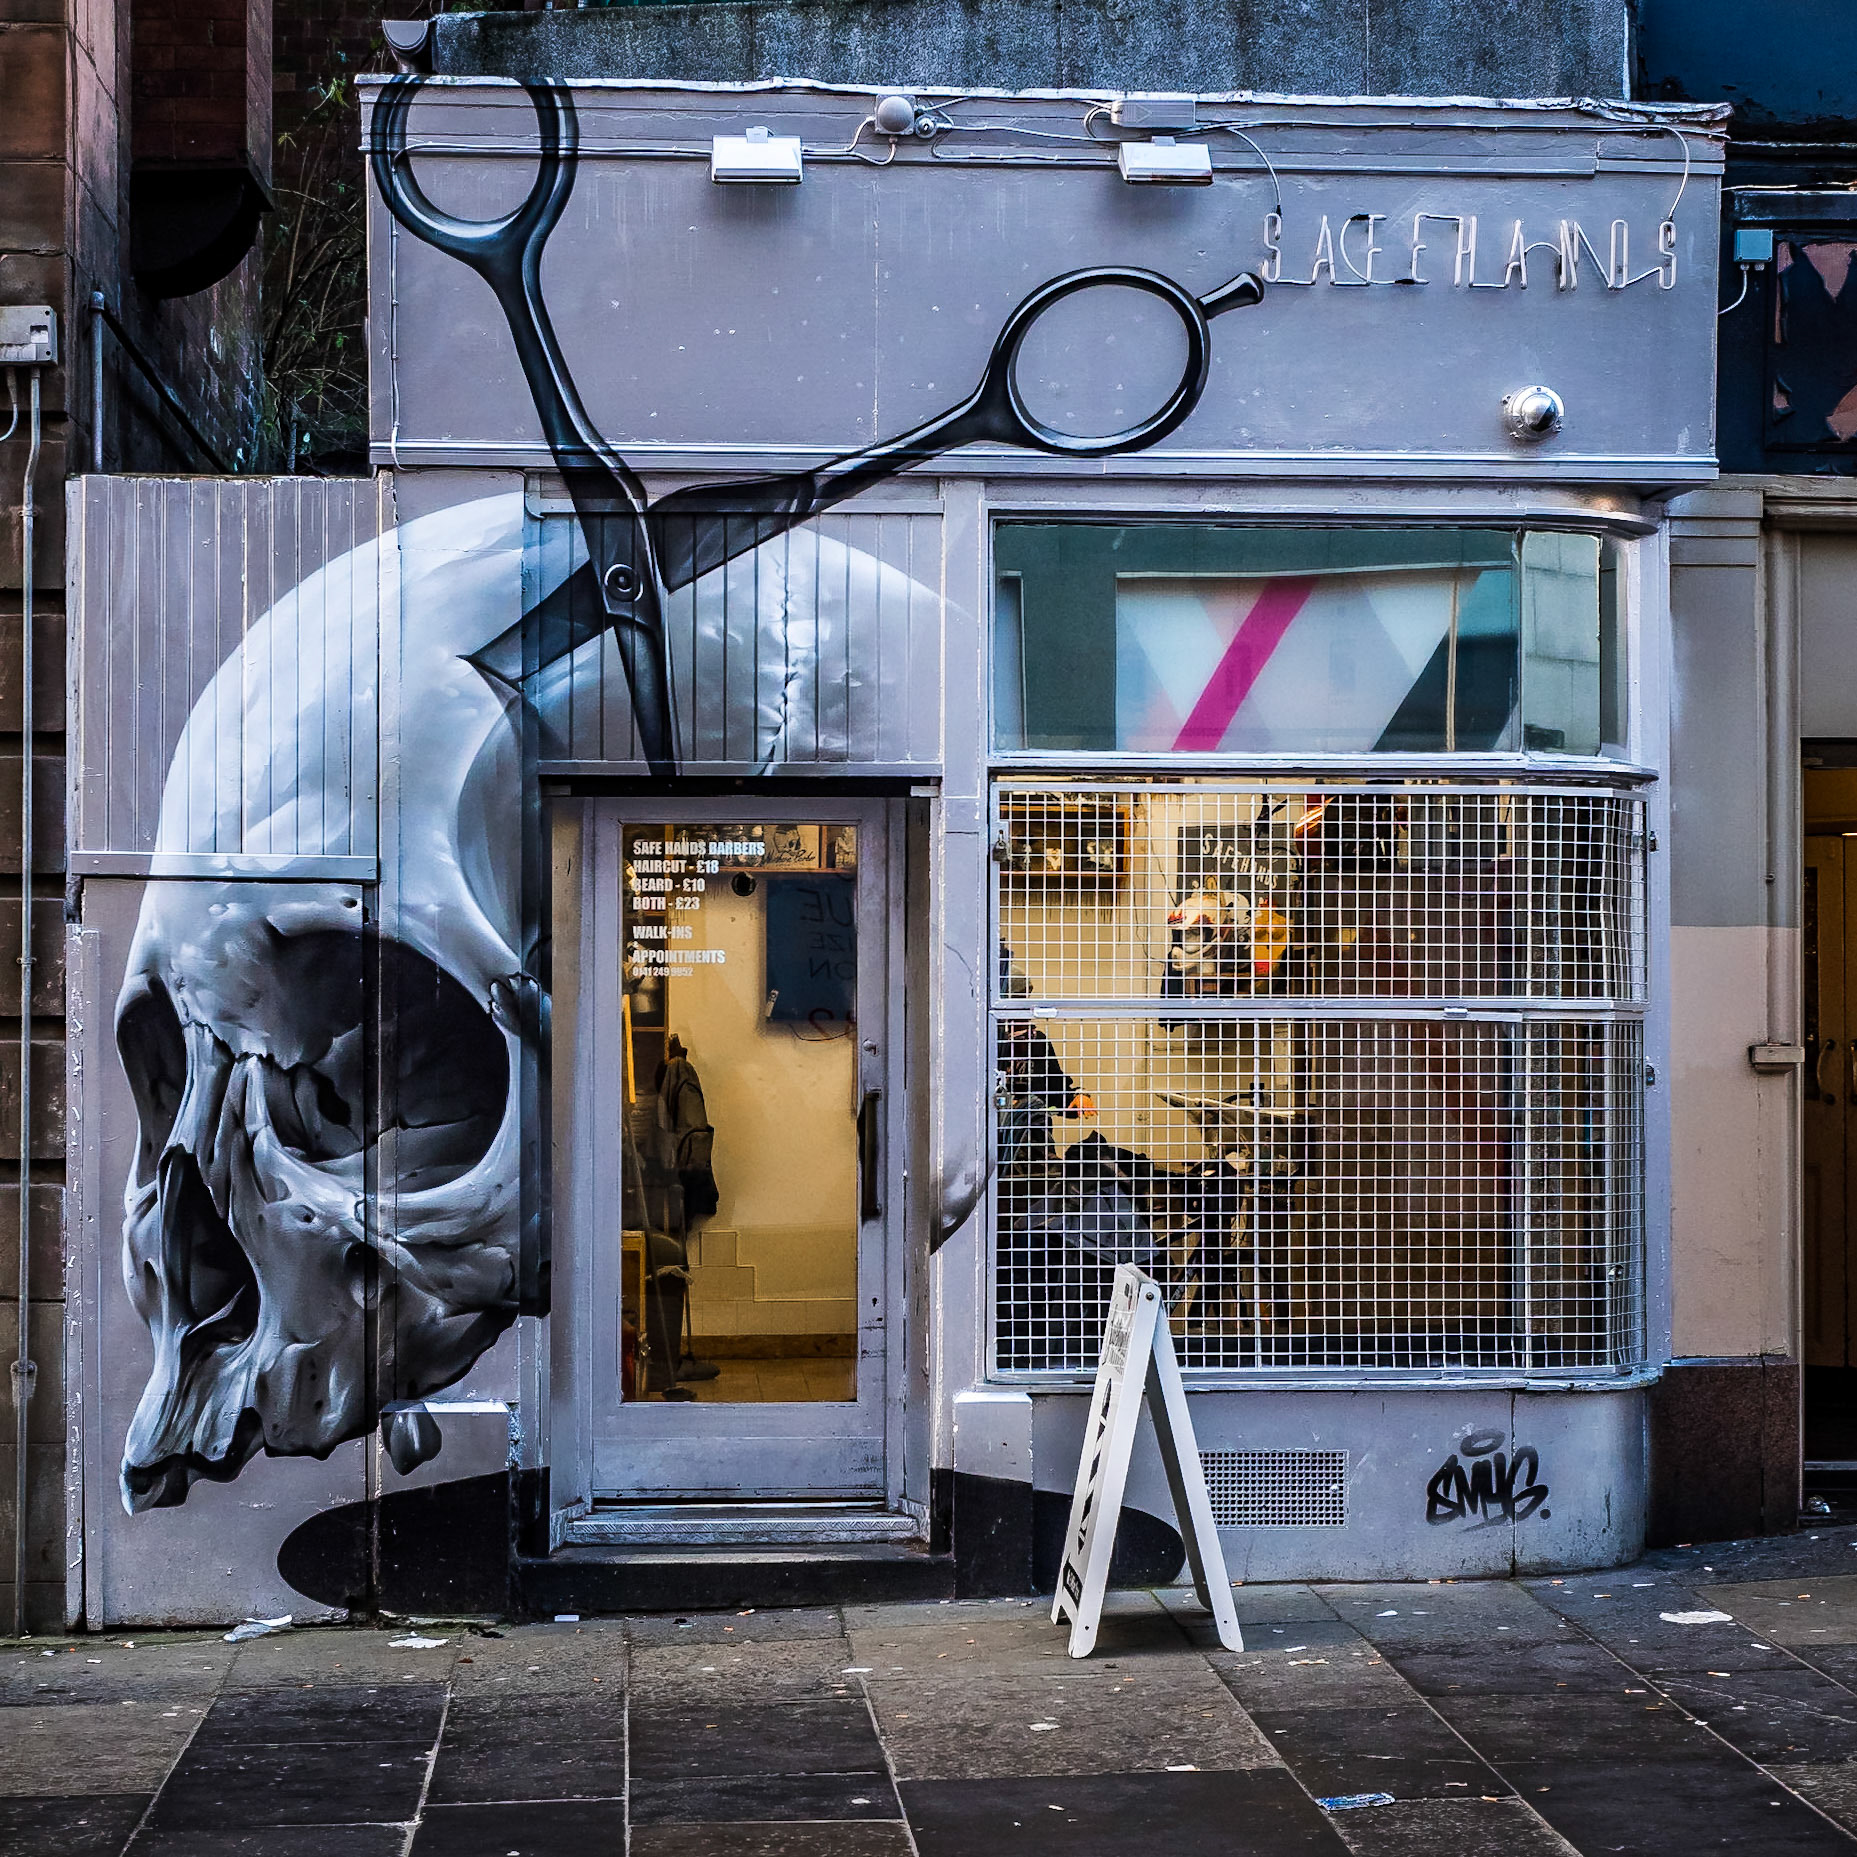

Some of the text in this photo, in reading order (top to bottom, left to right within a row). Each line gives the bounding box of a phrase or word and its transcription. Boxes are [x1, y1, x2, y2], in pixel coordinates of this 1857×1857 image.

[632, 841, 663, 856] SAFE
[664, 841, 707, 856] HANDS
[708, 841, 766, 856] BARBERS
[632, 859, 688, 874] HAIRCUT
[695, 859, 720, 875] £18
[632, 878, 674, 892] BEARD
[682, 877, 706, 892] £10
[632, 896, 667, 911] BOTH
[674, 896, 701, 911] £23
[632, 925, 693, 939] WALK-INS
[632, 949, 727, 964] APPOINTMENTS
